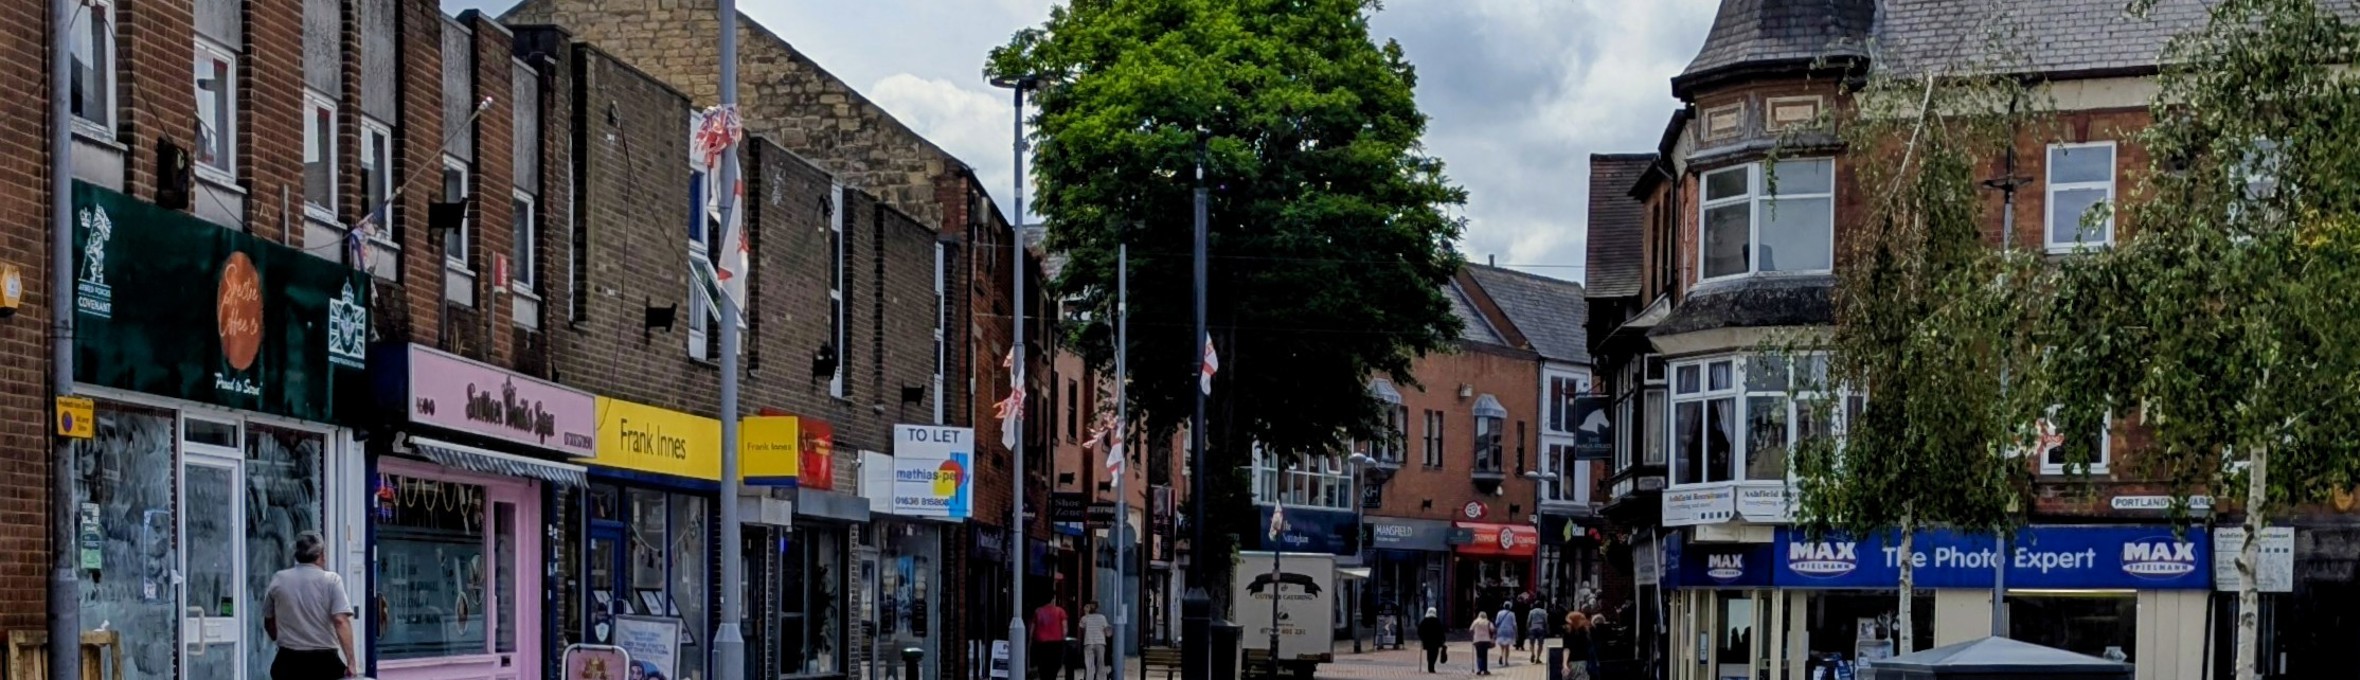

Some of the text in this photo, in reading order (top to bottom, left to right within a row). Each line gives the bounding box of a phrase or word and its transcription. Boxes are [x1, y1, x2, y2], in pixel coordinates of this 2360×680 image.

[620, 417, 654, 456] Frank
[657, 424, 686, 460] Innes
[907, 428, 960, 444] TO LET
[747, 442, 770, 451] Frank
[1743, 489, 1779, 498] Ashfield
[2115, 498, 2168, 507] PORTLAND
[1376, 525, 1413, 537] MANSFIELD
[1789, 542, 1856, 560] MAX
[2123, 542, 2195, 561] MAX
[1708, 554, 1743, 568] MAX
[1795, 562, 1851, 570] SPIELMANN
[1882, 546, 1927, 568] Te
[2014, 547, 2096, 574] Expert
